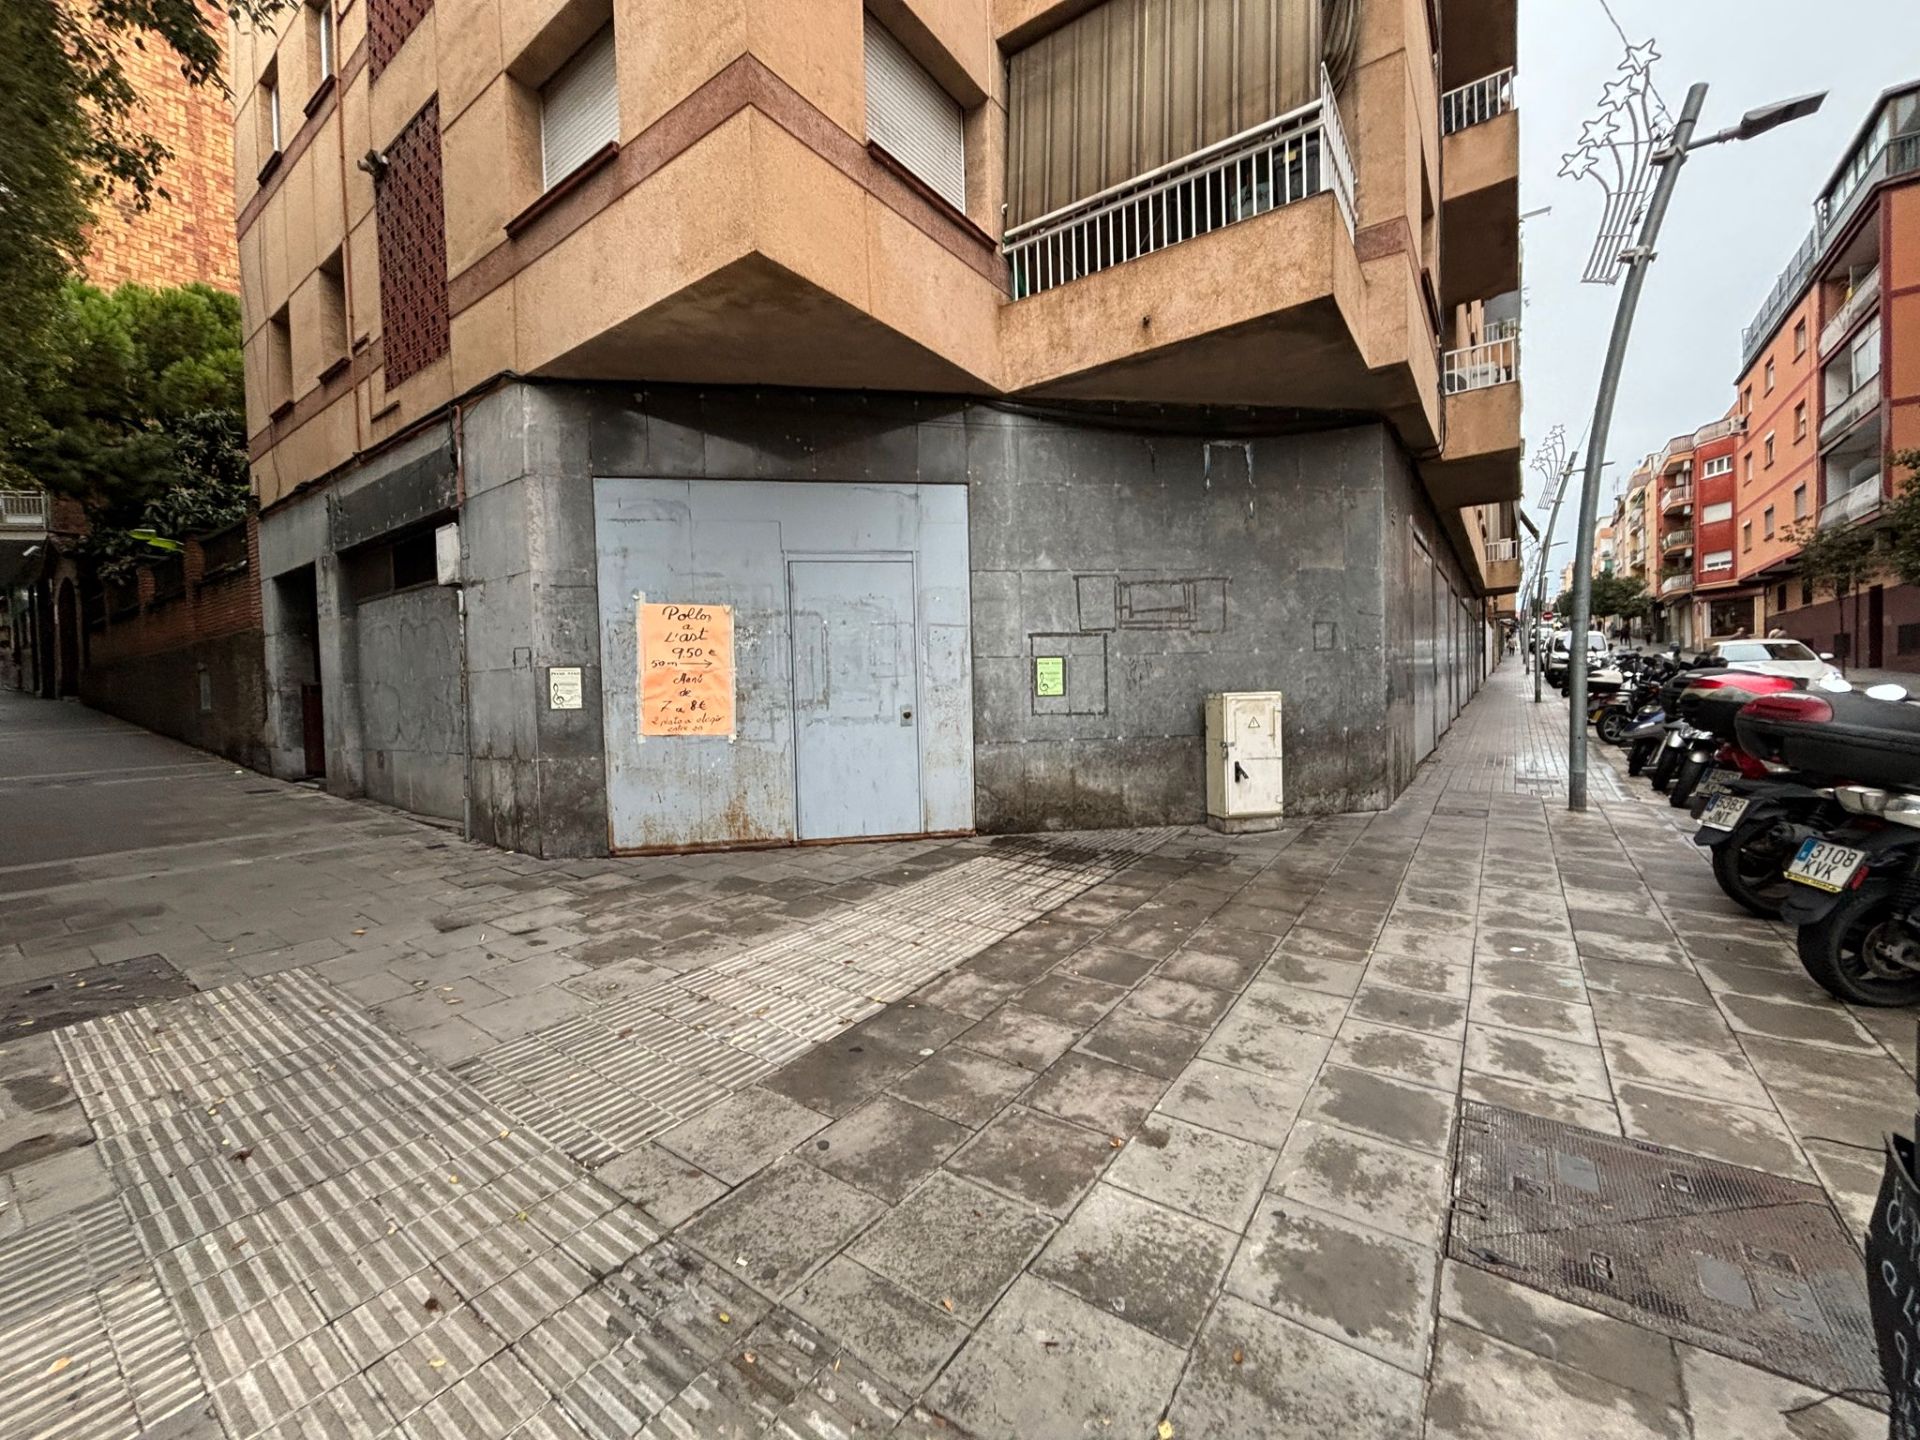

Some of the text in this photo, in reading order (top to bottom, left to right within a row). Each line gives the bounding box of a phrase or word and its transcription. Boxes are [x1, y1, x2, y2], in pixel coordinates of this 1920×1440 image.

[679, 688, 691, 696] de
[660, 700, 672, 712] 7
[1811, 844, 1857, 867] 3108
[1801, 859, 1838, 880] KVK
